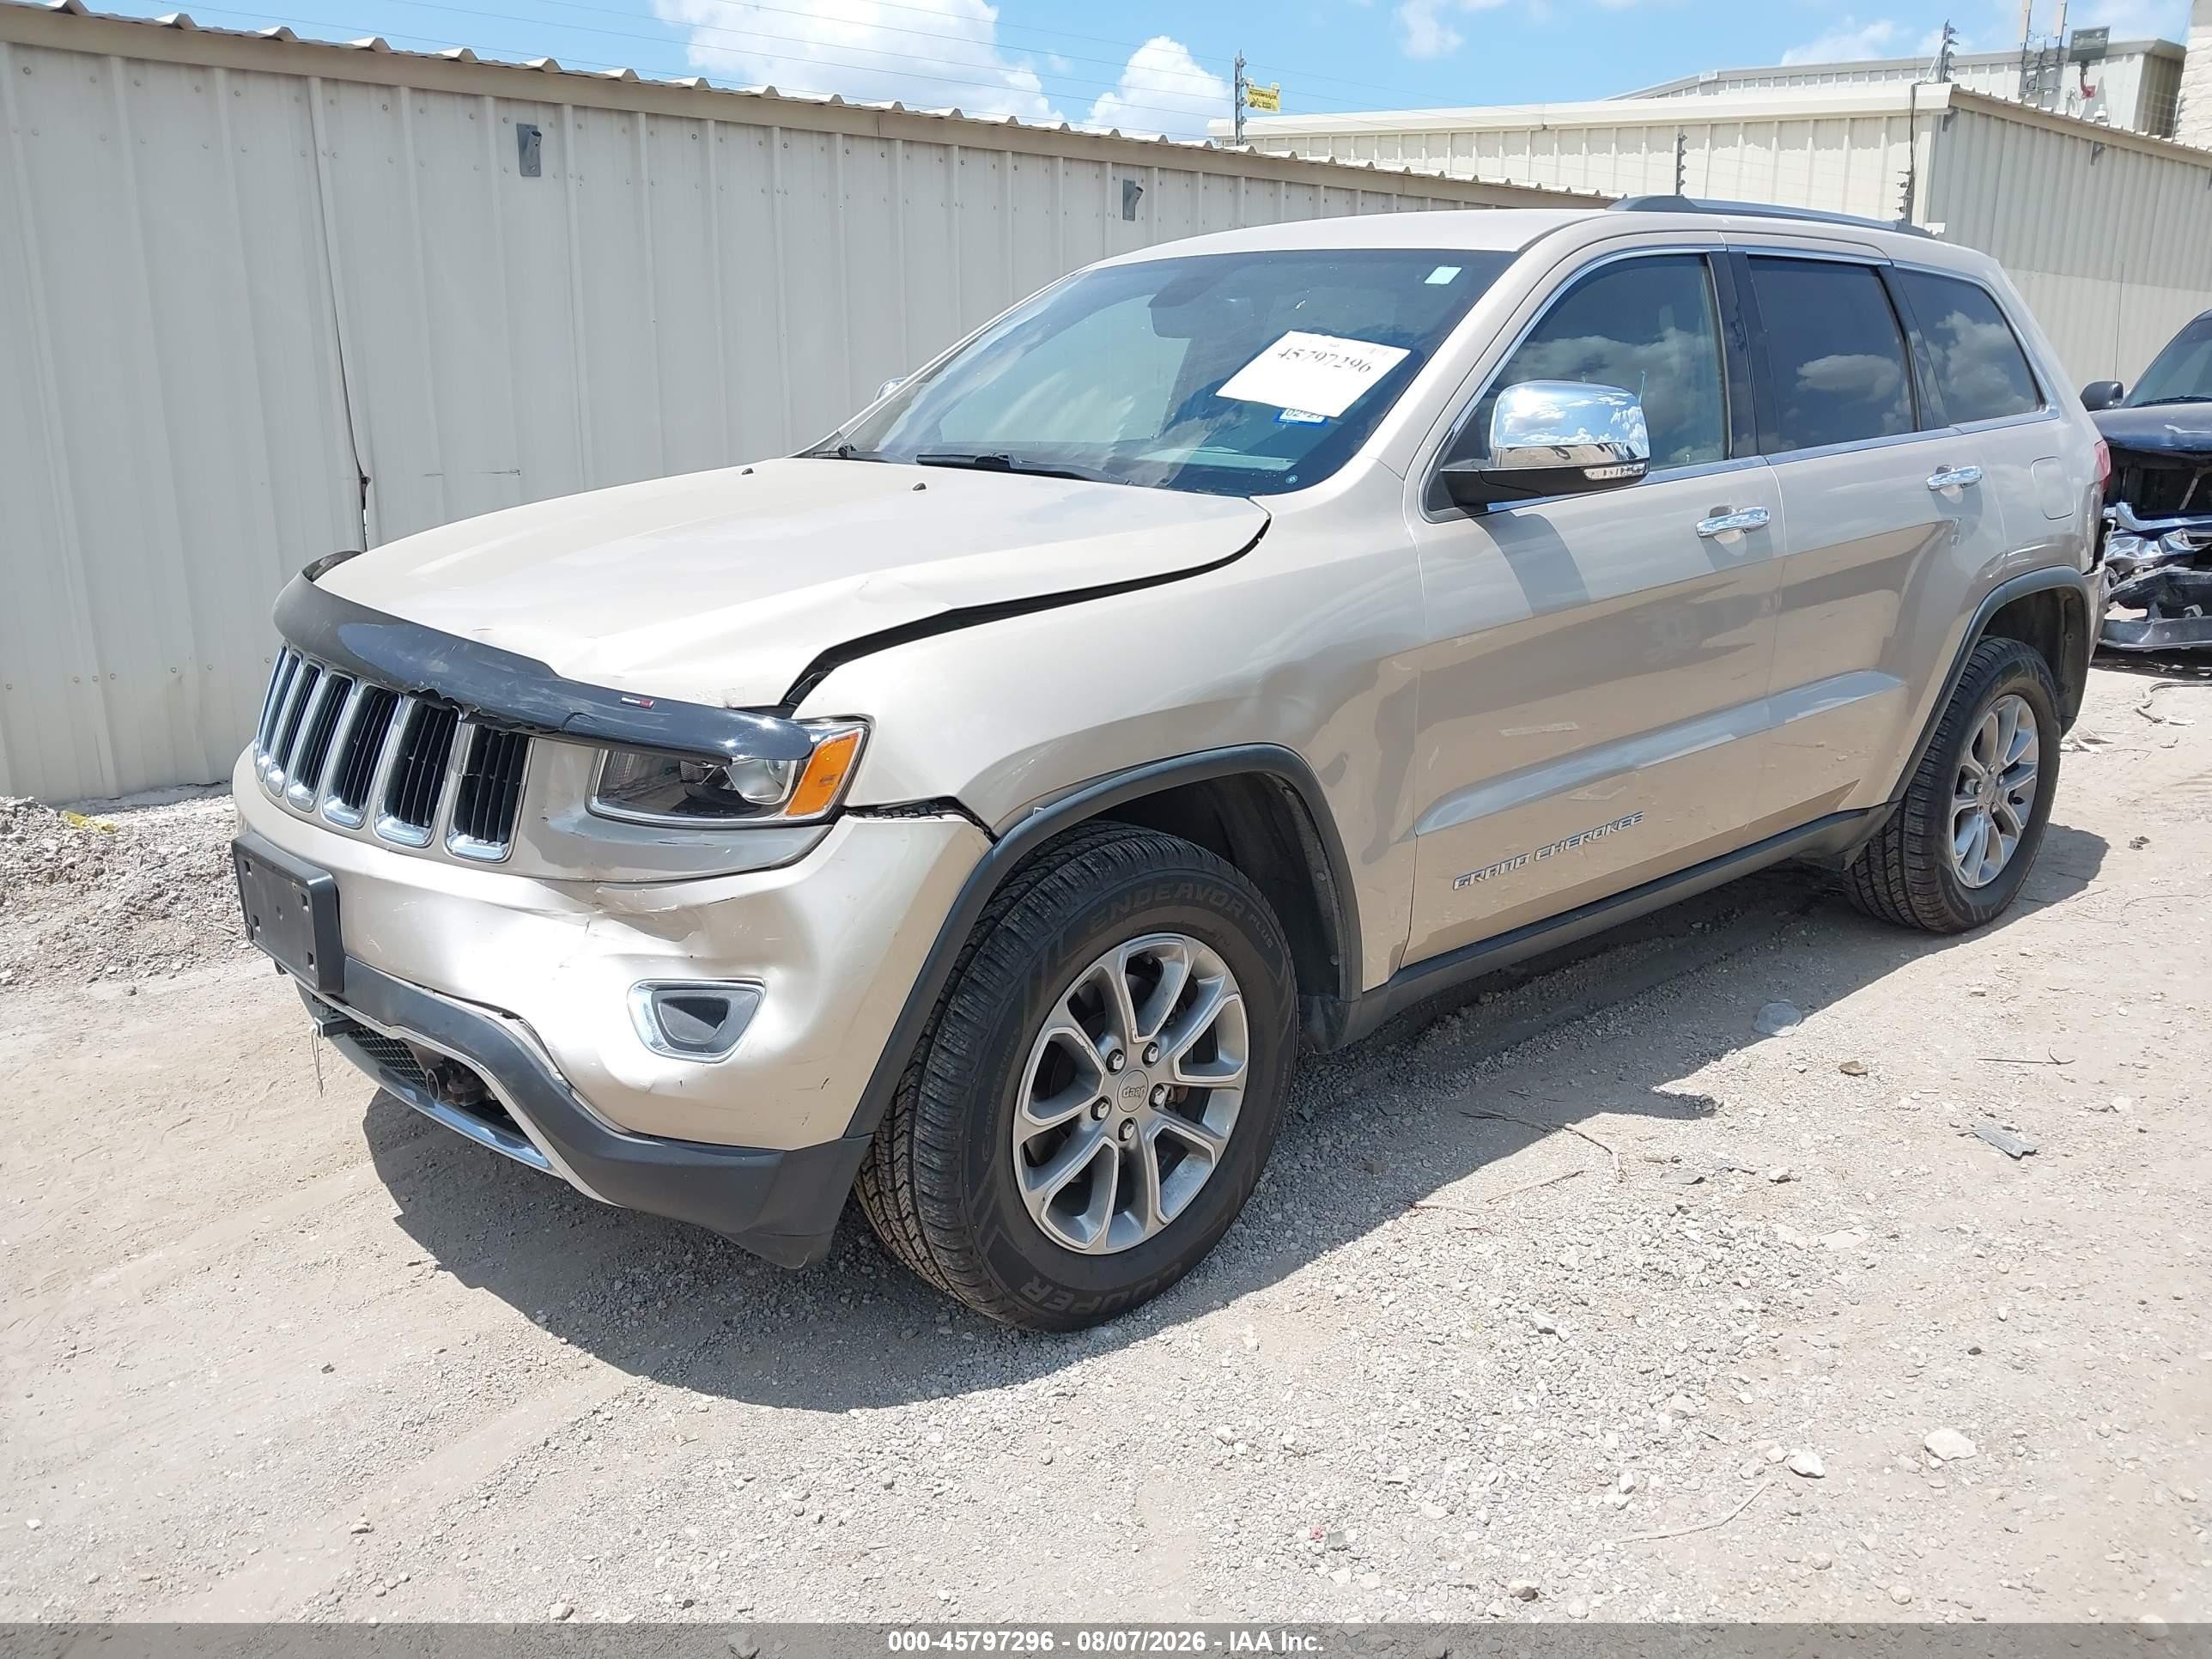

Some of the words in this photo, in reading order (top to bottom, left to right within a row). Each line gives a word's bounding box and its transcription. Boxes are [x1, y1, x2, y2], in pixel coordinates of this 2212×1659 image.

[1453, 853, 1530, 891] GRAND
[1534, 811, 1644, 862] CHEROKEE
[1088, 882, 1246, 934] ENDEAVOR
[1248, 912, 1275, 949] PLUS
[1121, 1085, 1146, 1098] Jeep
[1018, 1261, 1183, 1316] COOPER
